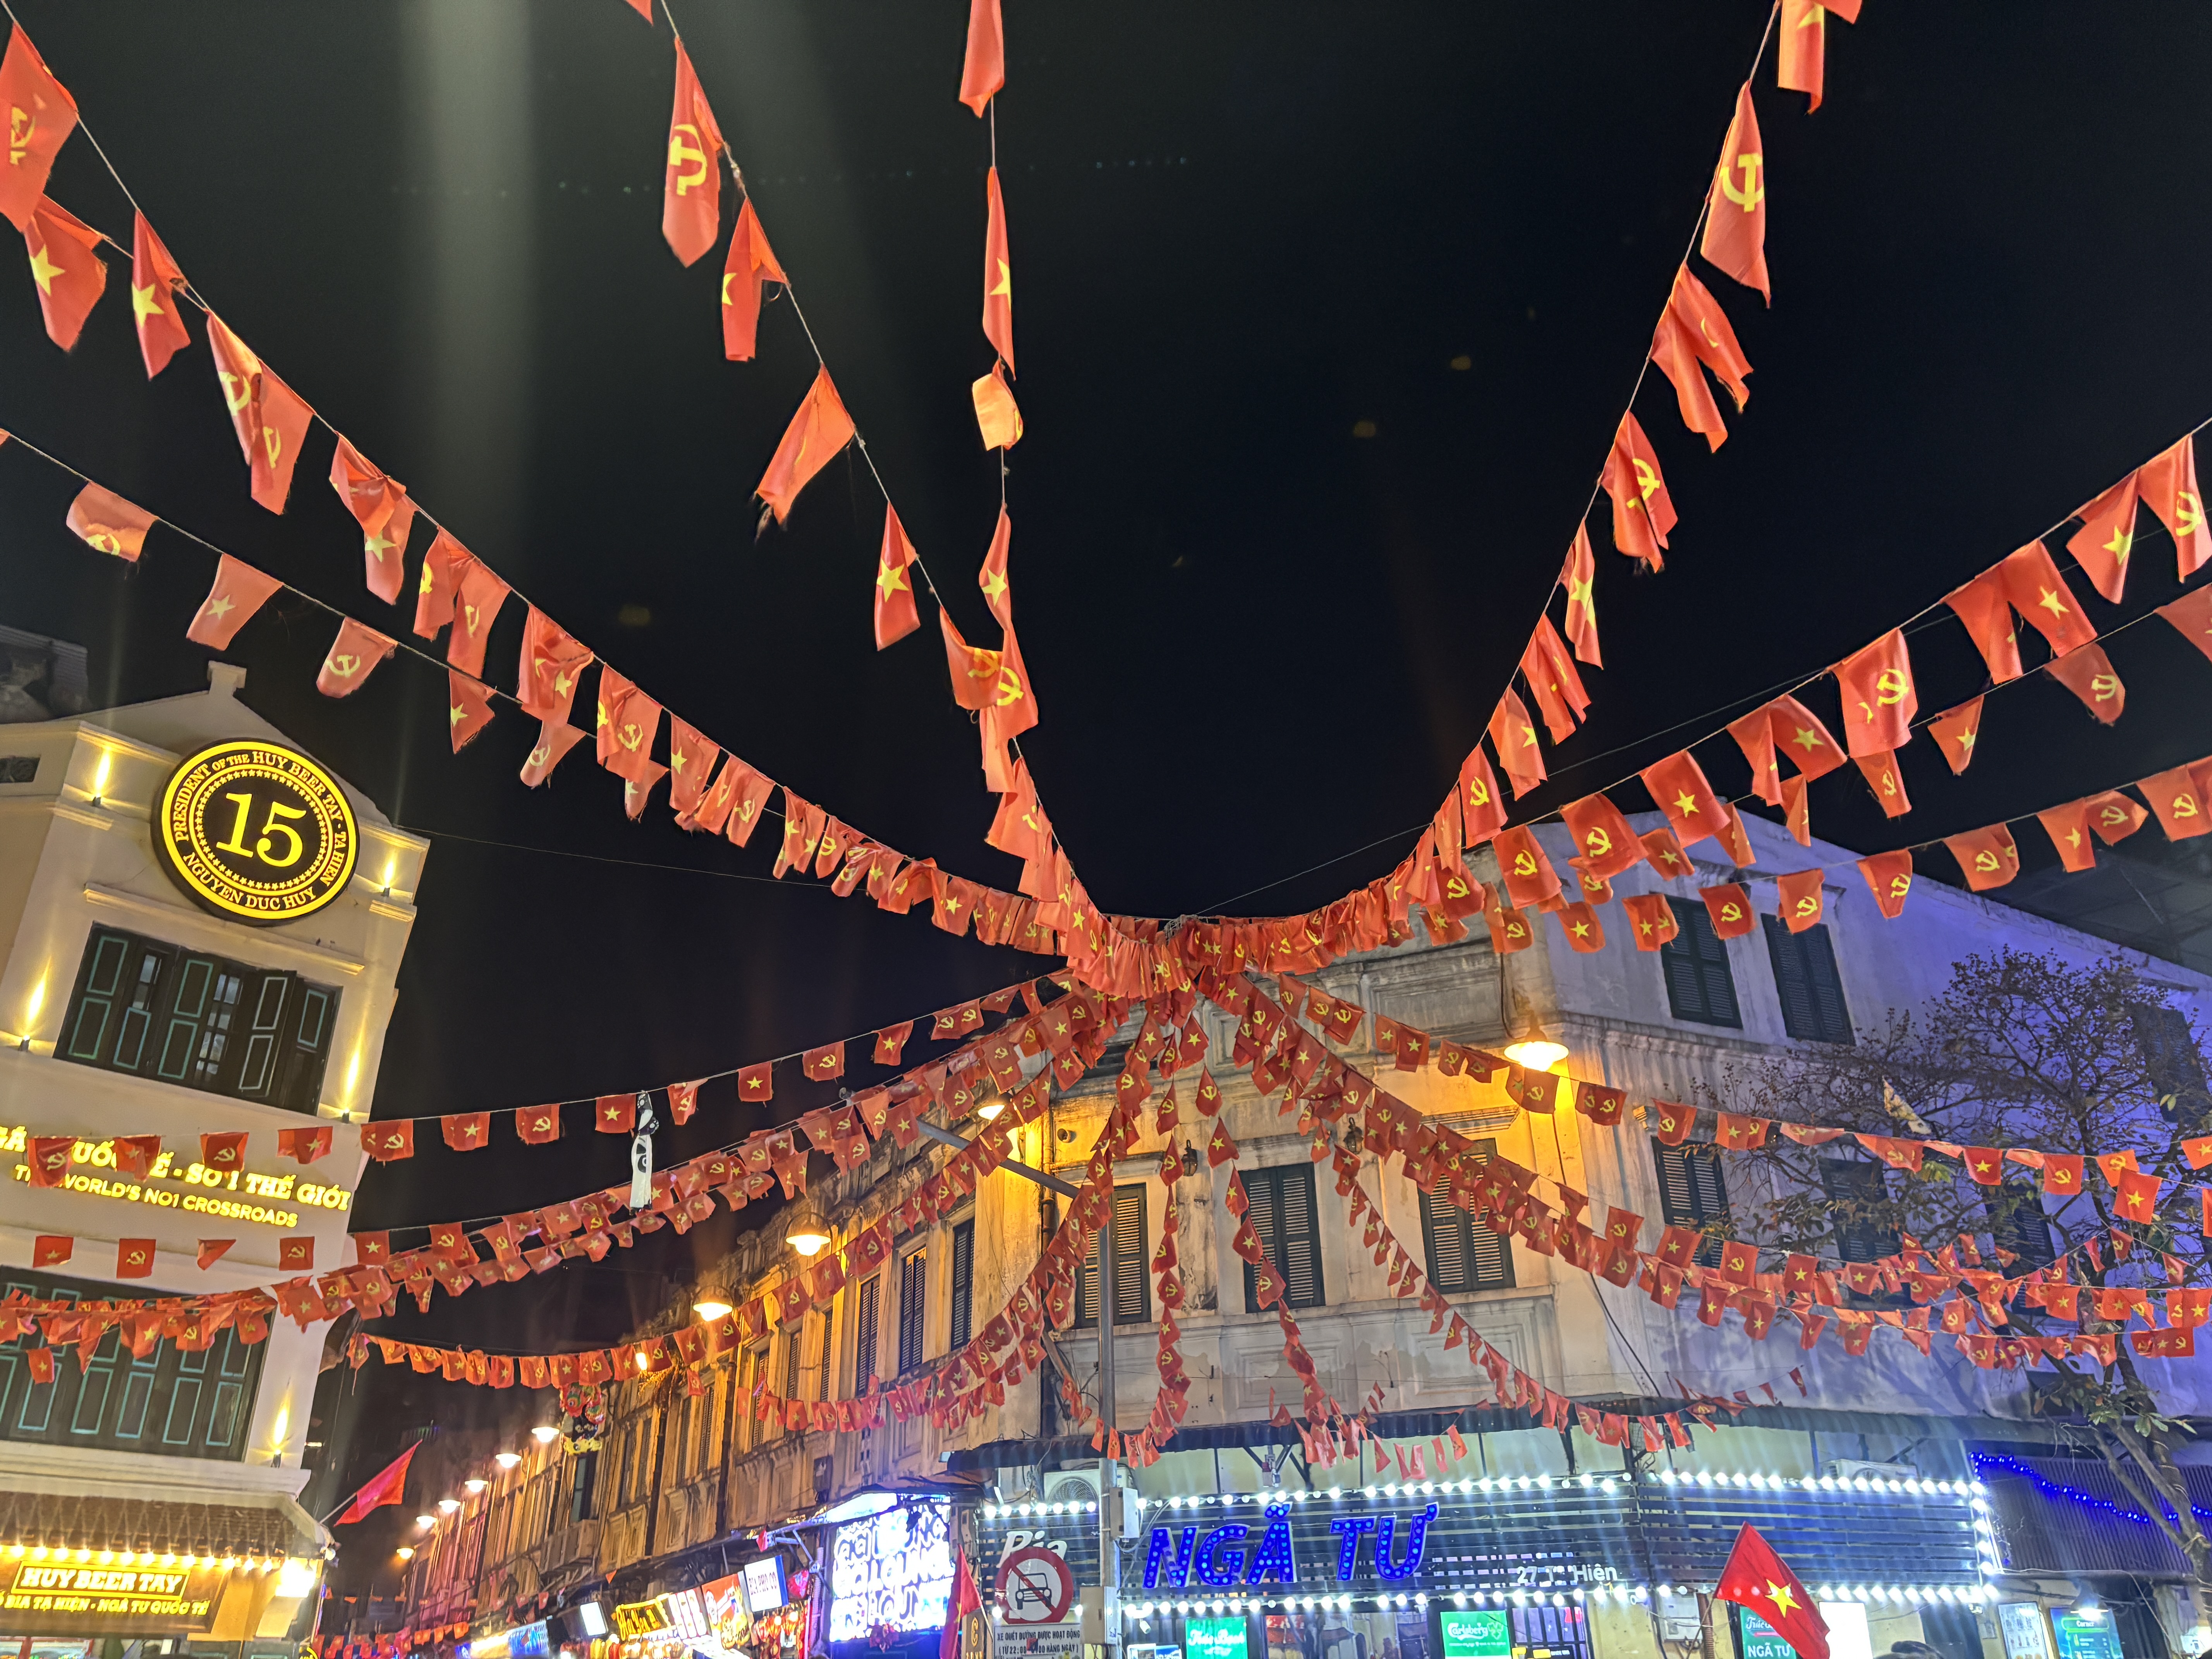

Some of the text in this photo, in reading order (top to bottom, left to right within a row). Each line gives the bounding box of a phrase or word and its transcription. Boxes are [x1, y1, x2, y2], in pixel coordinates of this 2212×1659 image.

[212, 758, 226, 772] OF
[227, 754, 250, 766] THE
[252, 751, 289, 769] HUY
[289, 763, 327, 795] BEER
[173, 764, 211, 842] PRESIDENT
[321, 795, 343, 822] TAY
[216, 793, 306, 867] 15
[336, 831, 347, 847] TA
[320, 848, 345, 887] HIEN
[183, 852, 316, 910] NGUYEN DUC HUY
[246, 1174, 297, 1200] THẾ
[297, 1184, 351, 1211] GIỚI
[144, 1188, 180, 1207] NO1
[183, 1195, 298, 1228] CROSSROADS
[1142, 1501, 1440, 1588] NGÃ TƯ
[21, 1567, 183, 1593] HUY BEER TAY
[1517, 1566, 1537, 1583] 27
[997, 1633, 1003, 1641] XE
[1448, 1623, 1488, 1638] Carlsberg
[1748, 1642, 1774, 1657] NGÃ
